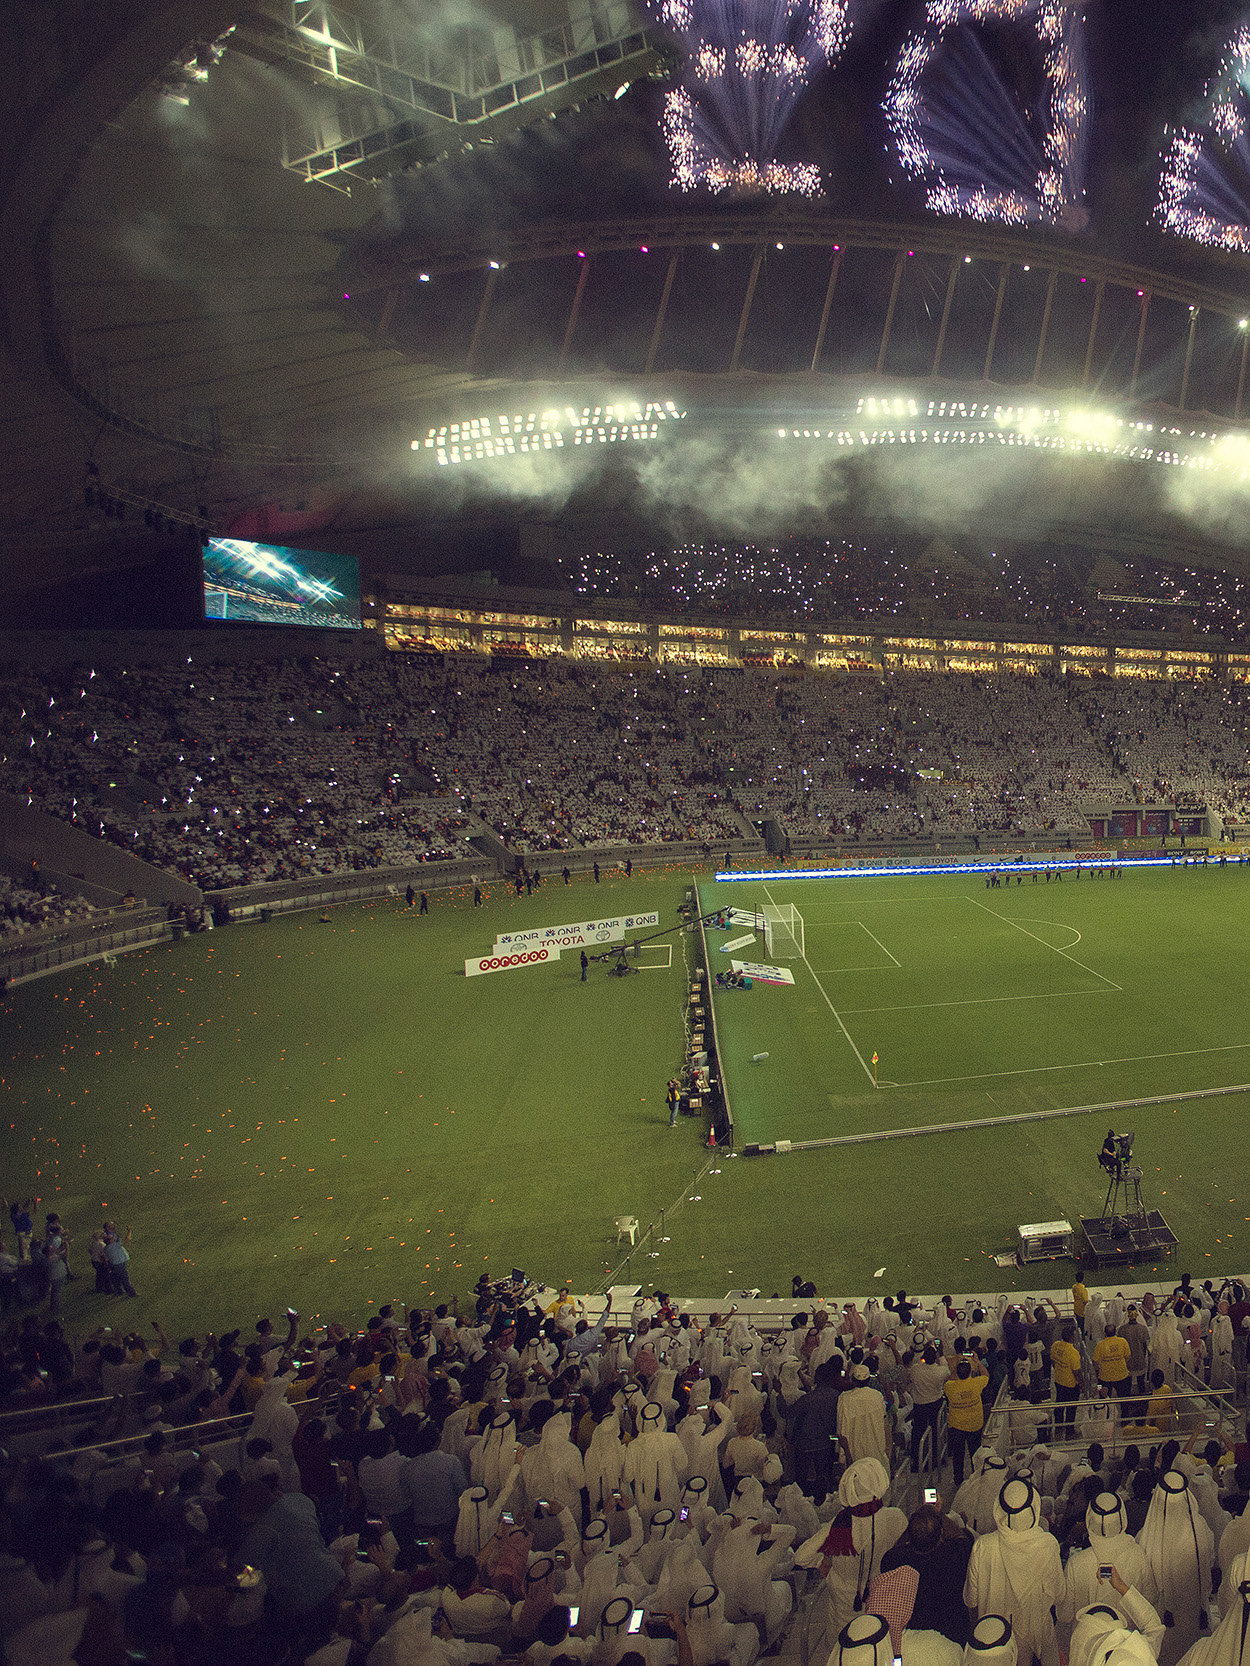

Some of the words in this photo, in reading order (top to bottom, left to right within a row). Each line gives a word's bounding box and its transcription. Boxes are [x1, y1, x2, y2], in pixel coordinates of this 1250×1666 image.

[865, 859, 883, 867] QNB
[893, 858, 910, 866] QNB
[930, 857, 959, 865] TOYOTA
[635, 914, 657, 926] QNB
[479, 949, 549, 971] ooredoo
